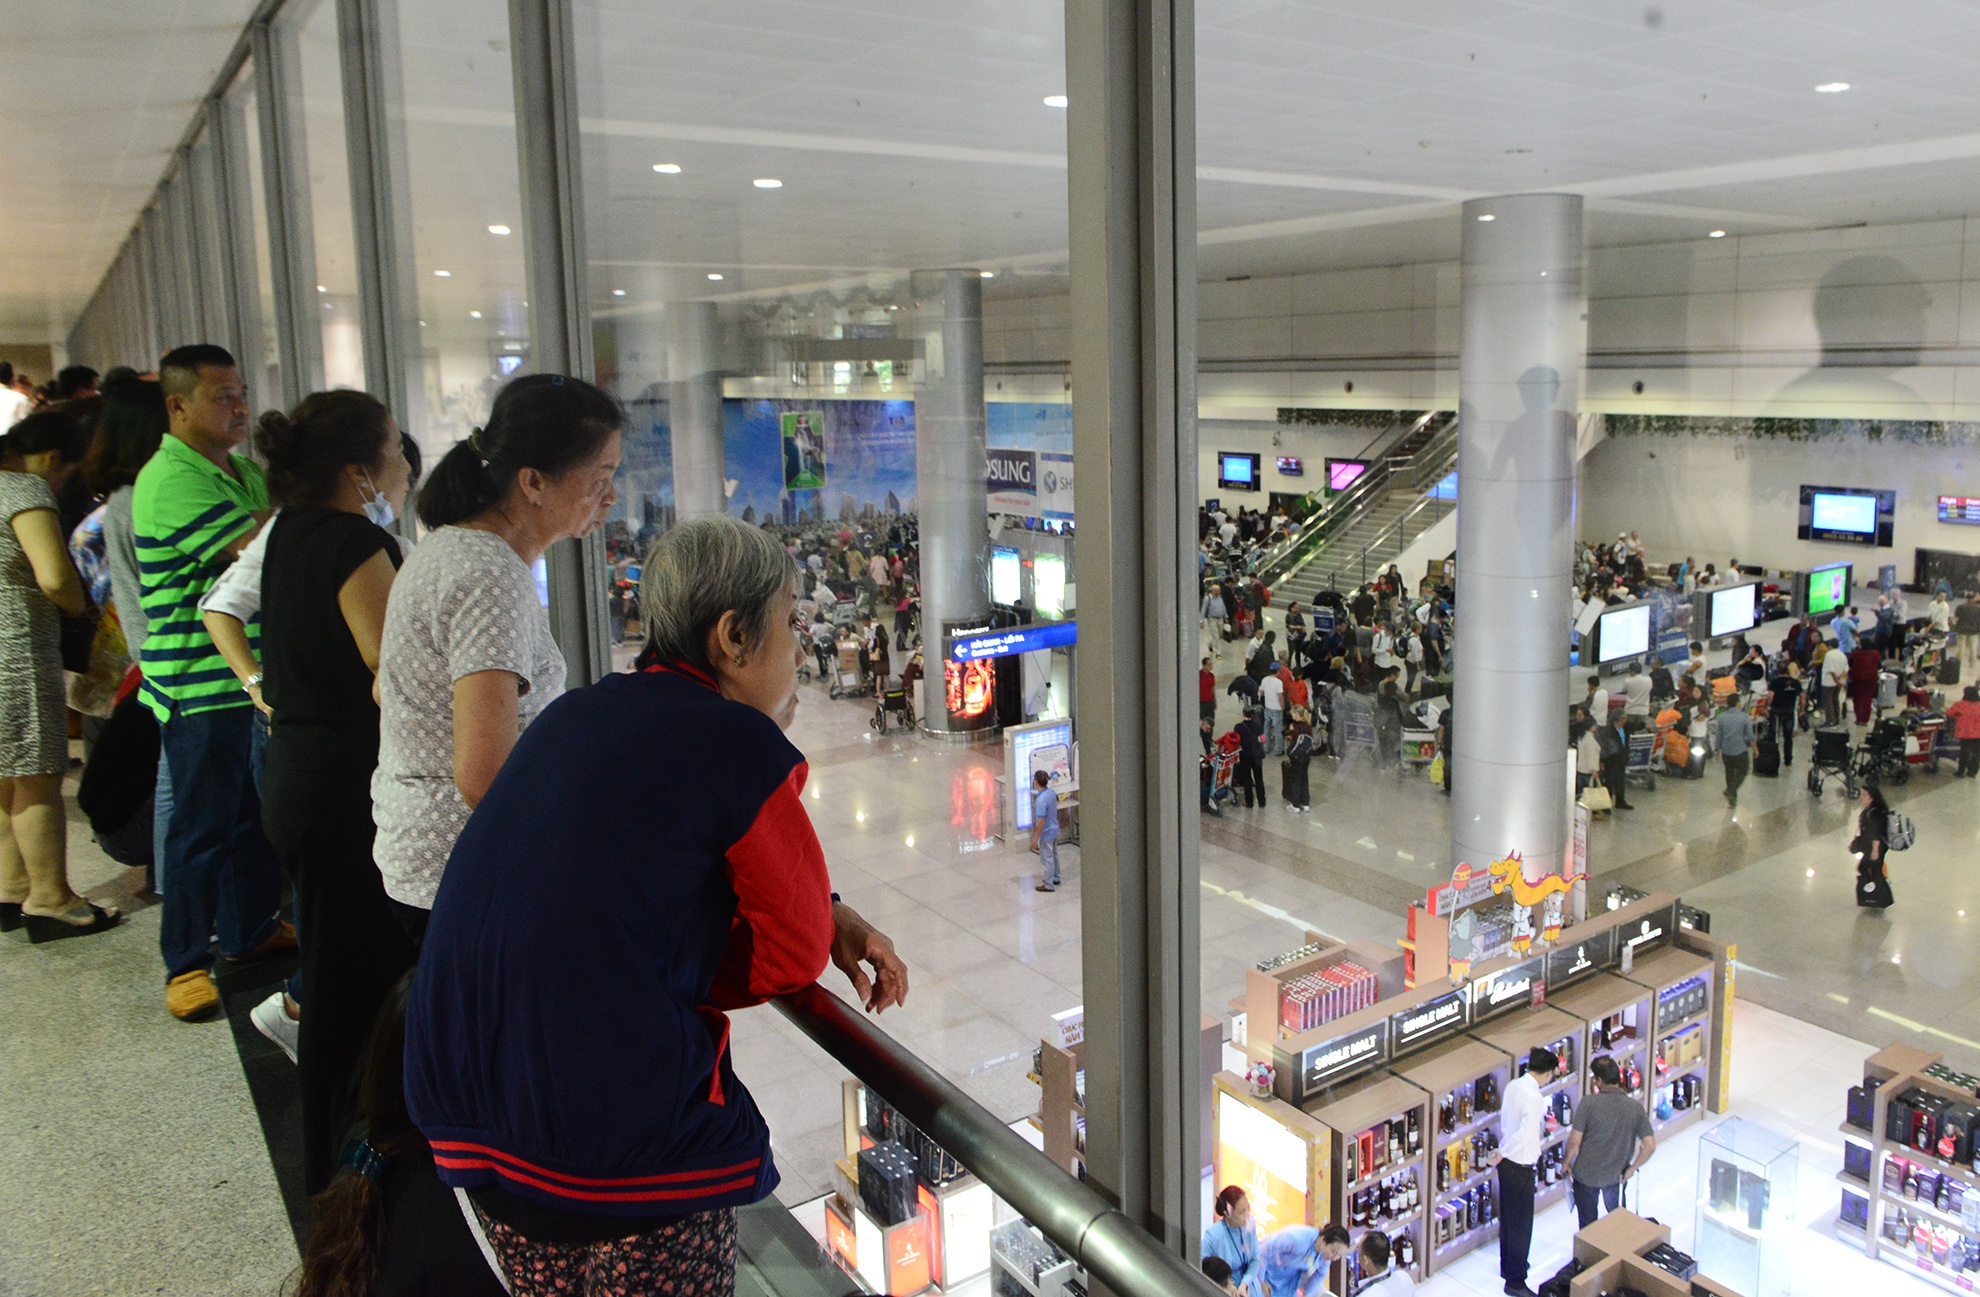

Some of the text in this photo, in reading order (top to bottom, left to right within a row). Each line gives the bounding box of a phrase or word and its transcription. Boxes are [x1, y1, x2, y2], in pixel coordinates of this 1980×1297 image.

[1402, 1000, 1460, 1034] SINGLE MALT
[1314, 1034, 1377, 1071] SINGLE MALT
